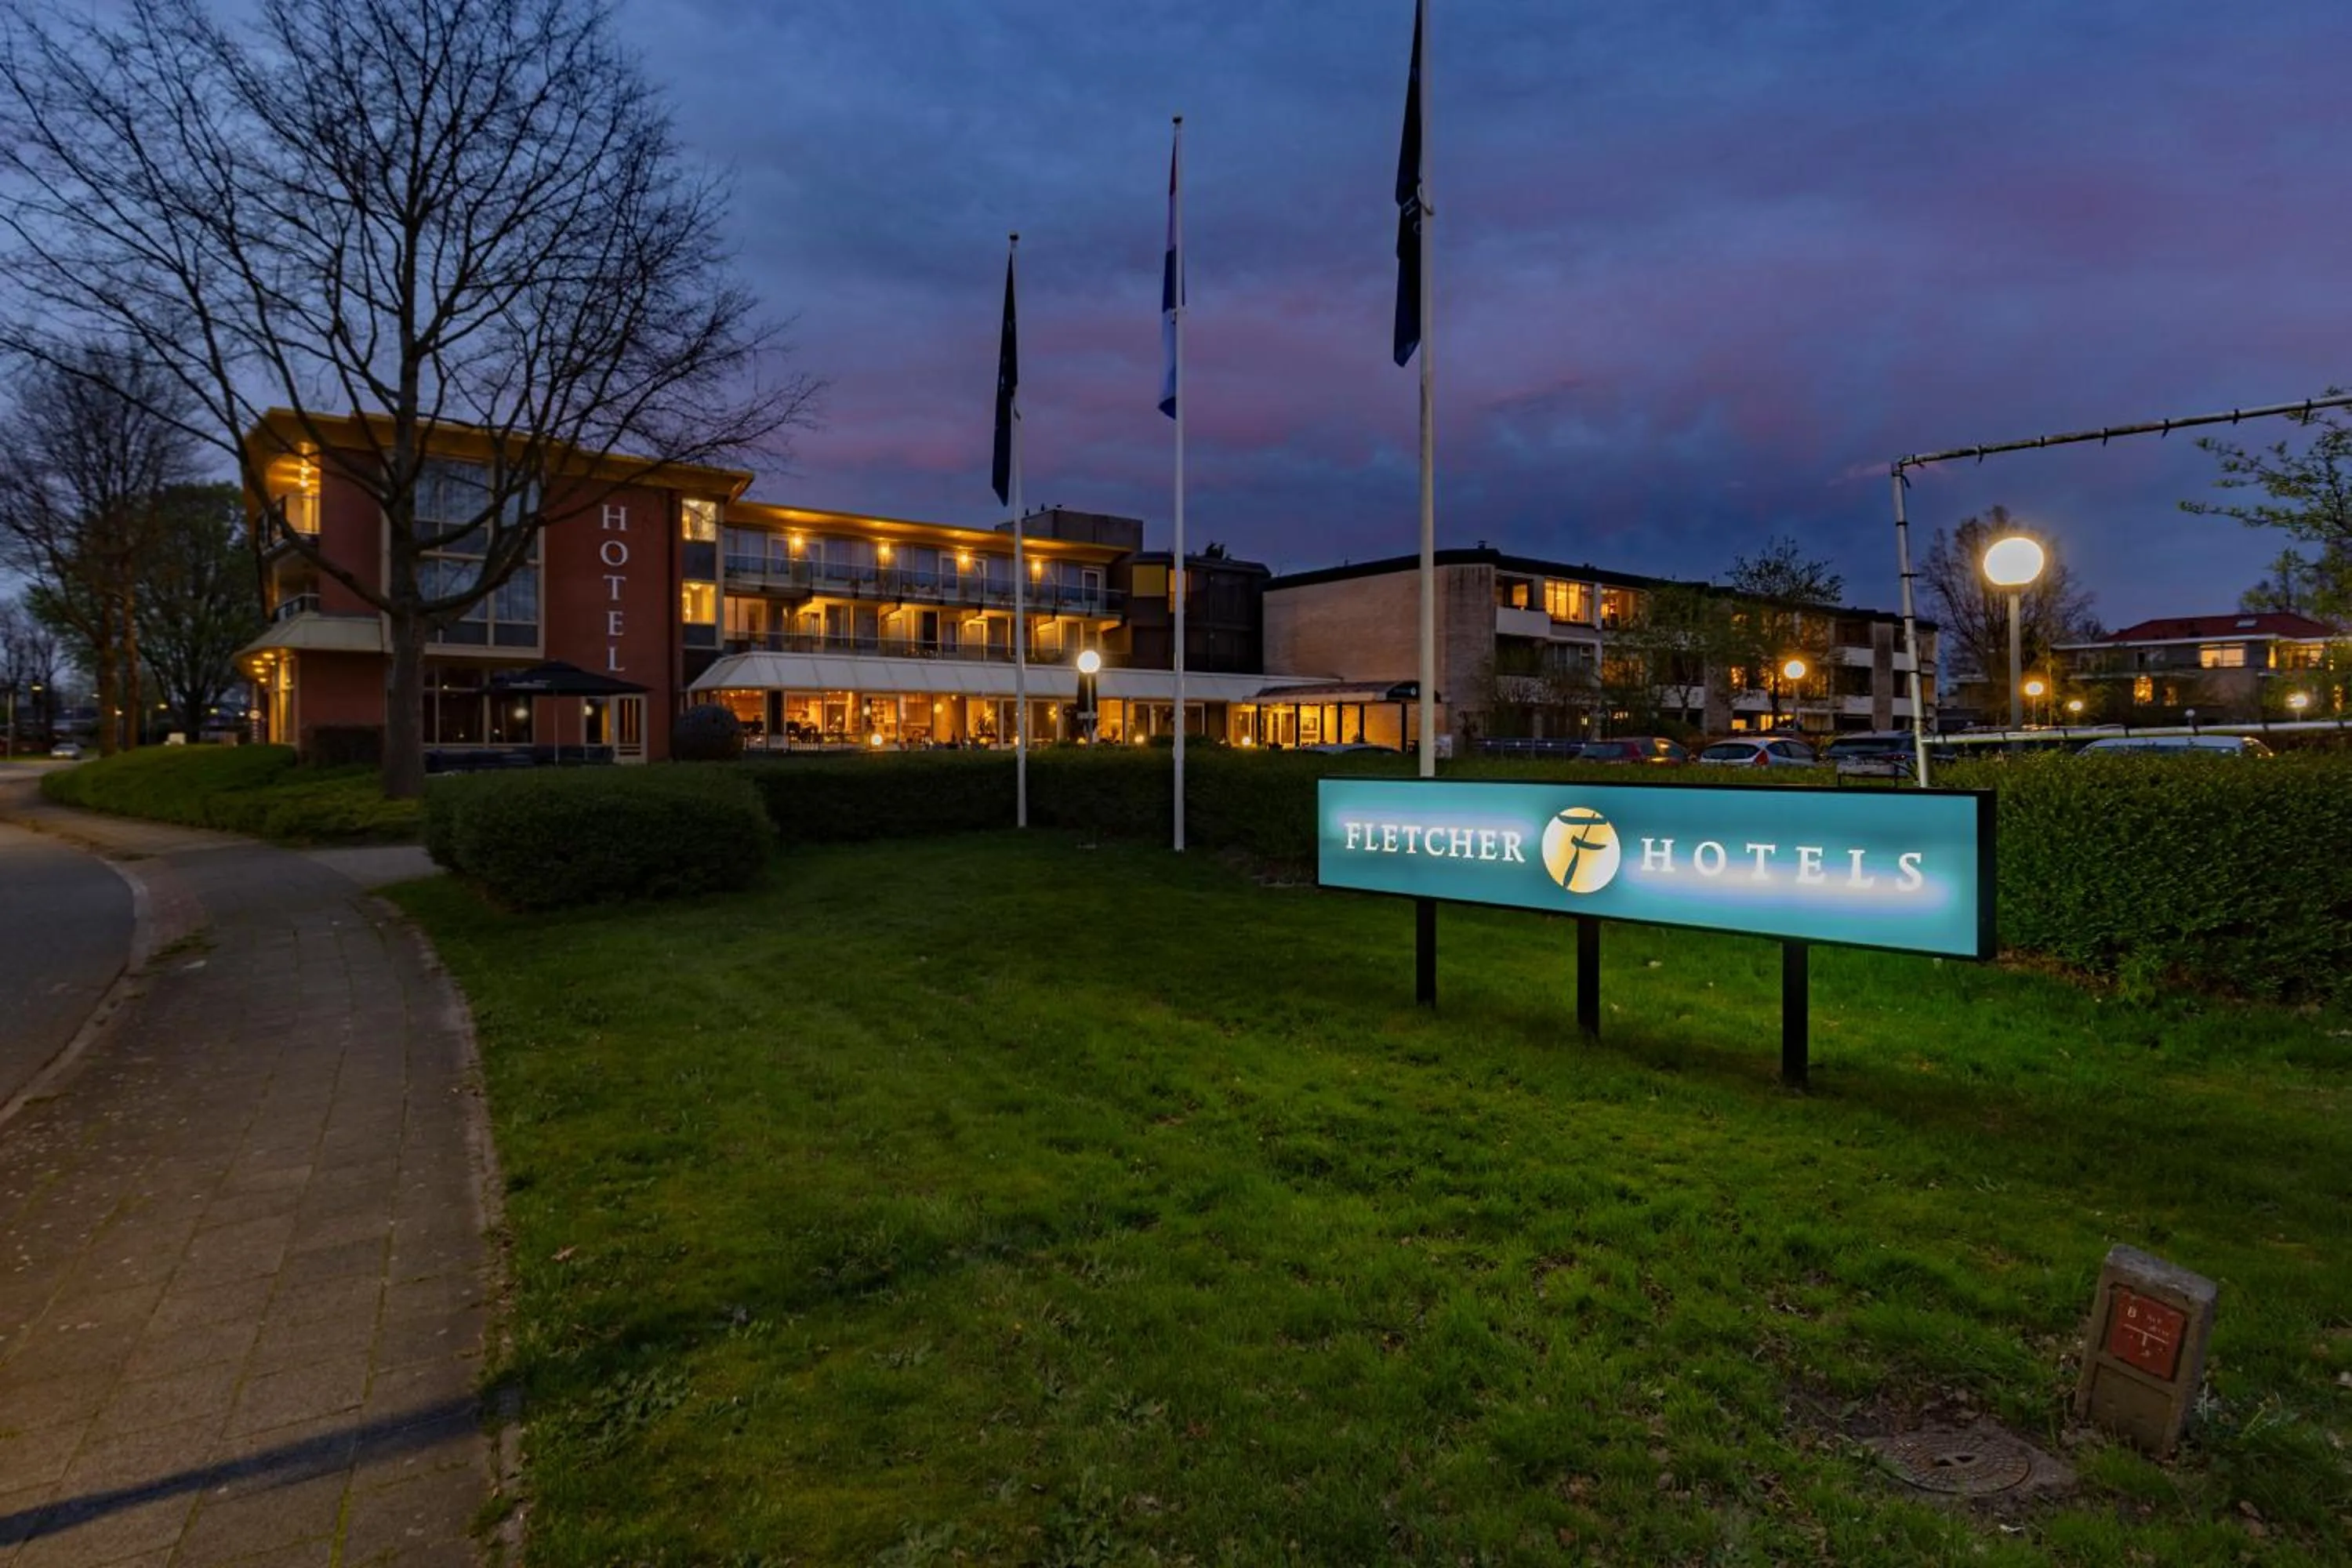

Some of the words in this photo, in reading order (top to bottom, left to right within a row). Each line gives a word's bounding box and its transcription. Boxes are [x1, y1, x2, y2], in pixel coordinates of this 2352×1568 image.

[600, 504, 629, 672] HOTEL
[1345, 822, 1526, 862] FLETCHER
[1640, 838, 1924, 891] HOTELS
